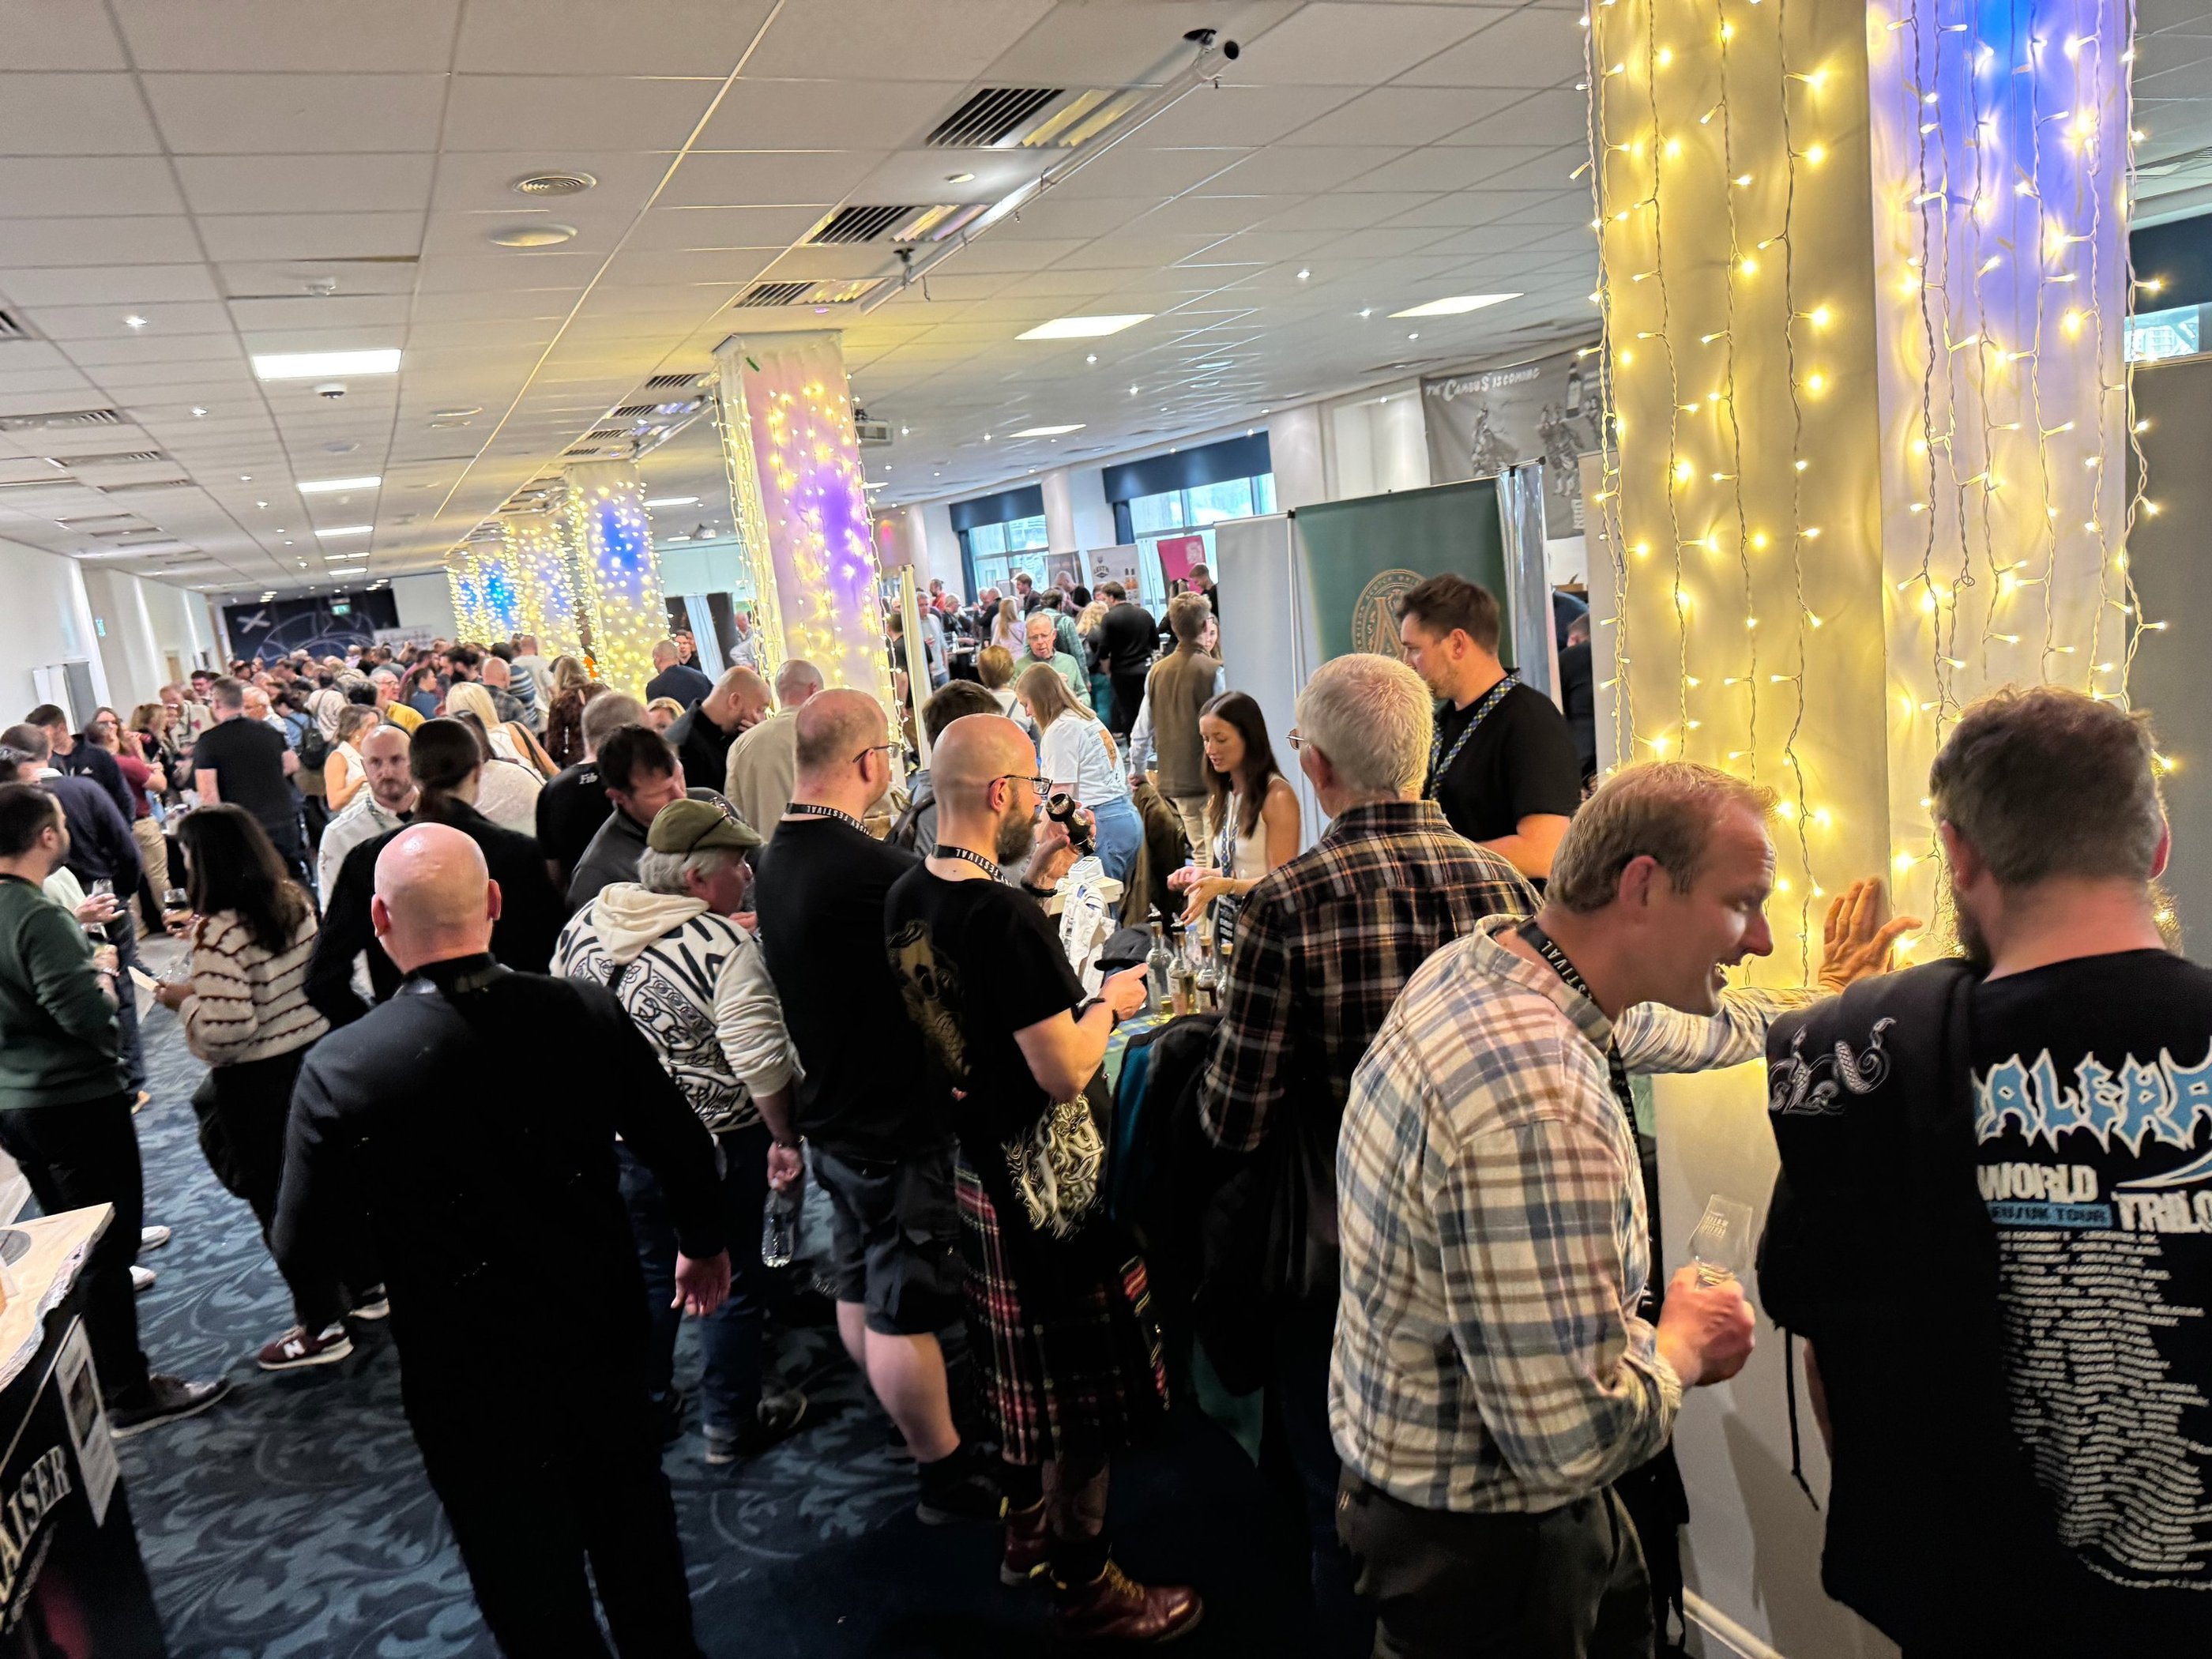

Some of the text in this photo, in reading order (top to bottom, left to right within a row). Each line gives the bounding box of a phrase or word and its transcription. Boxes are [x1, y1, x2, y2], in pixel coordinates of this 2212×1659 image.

[807, 805, 848, 822] FESTIVAL
[956, 848, 999, 876] FESTIVAL
[1541, 940, 1593, 999] STIVAL
[1977, 1161, 2099, 1204] WORLD
[0, 1444, 72, 1616] AISER
